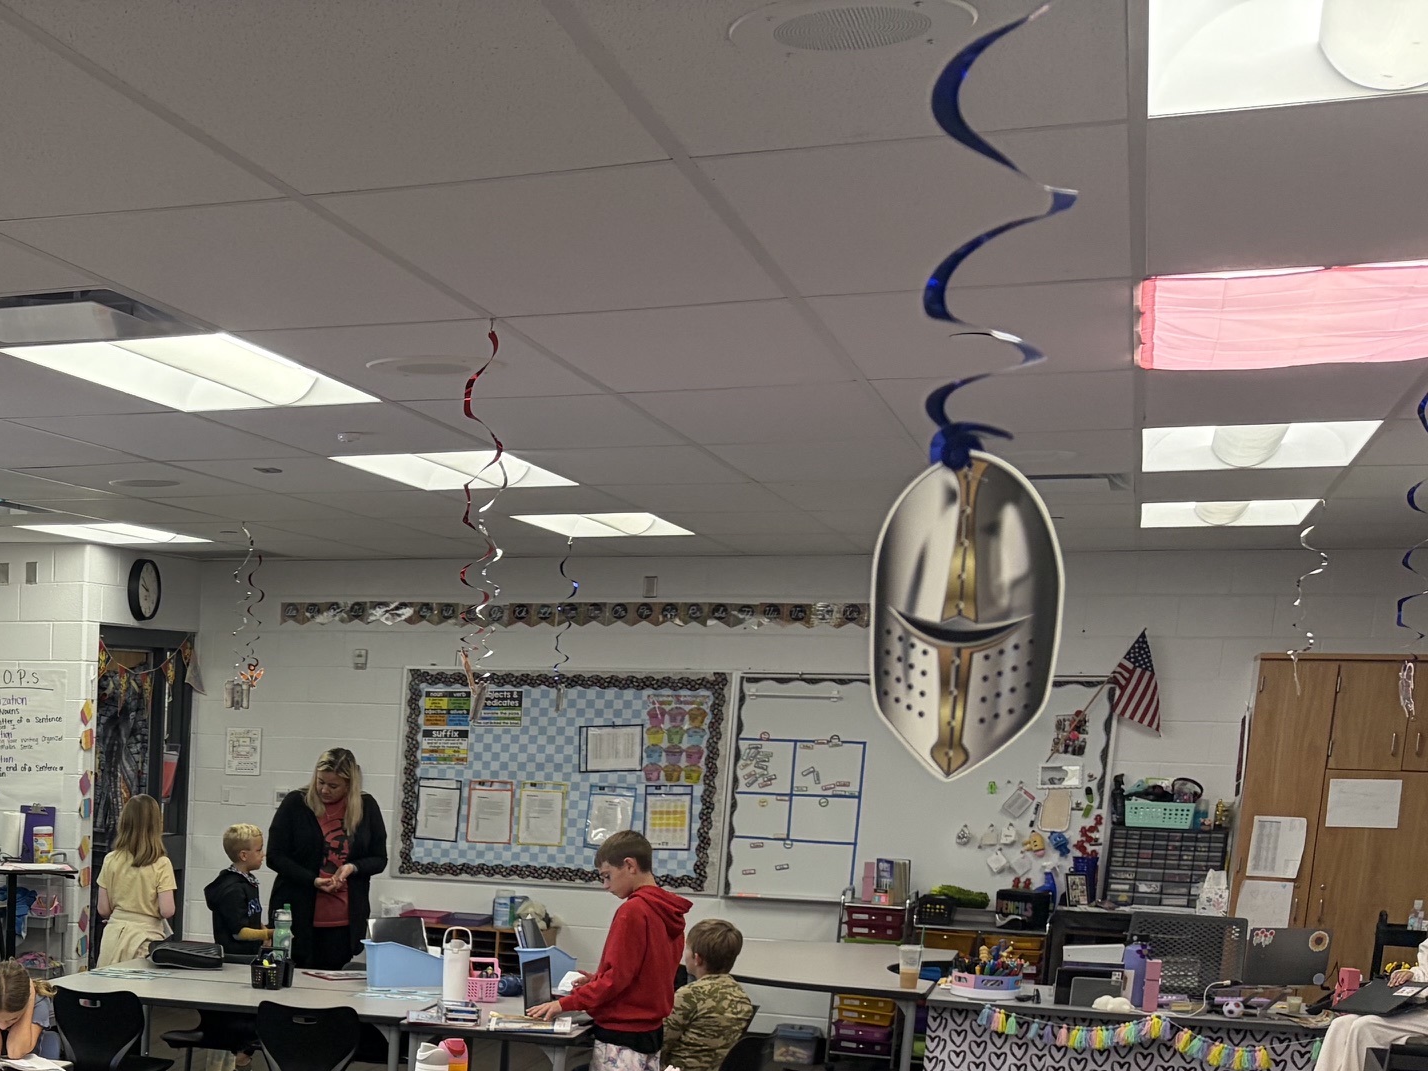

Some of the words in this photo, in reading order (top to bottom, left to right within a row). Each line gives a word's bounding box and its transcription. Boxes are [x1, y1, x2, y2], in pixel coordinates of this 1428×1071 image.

[16, 716, 24, 724] of
[432, 730, 460, 738] suffix
[6, 764, 18, 772] end
[996, 898, 1034, 918] PENCILS
